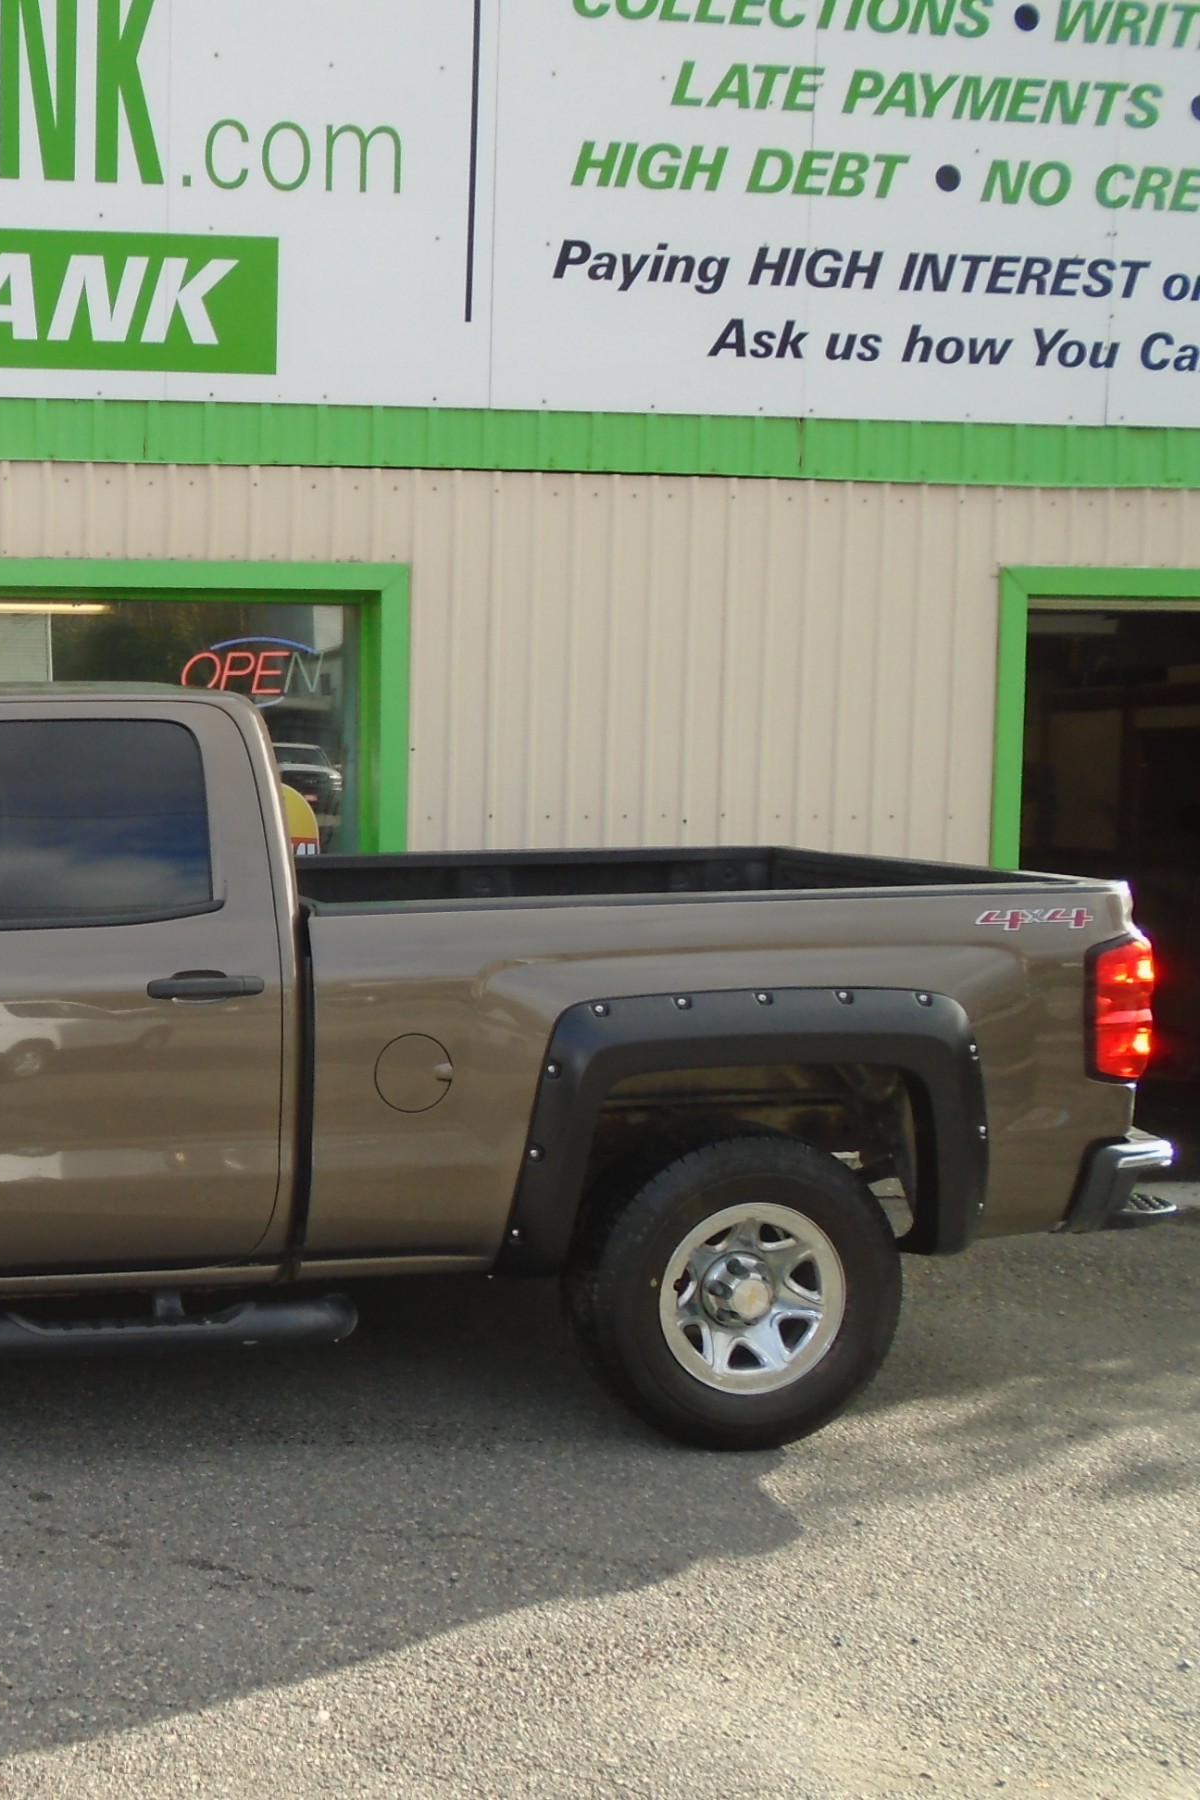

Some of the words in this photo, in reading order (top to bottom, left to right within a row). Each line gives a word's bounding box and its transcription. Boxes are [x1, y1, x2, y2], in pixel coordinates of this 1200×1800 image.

[670, 61, 825, 112] LATE
[841, 69, 1164, 129] PAYMENTS
[570, 141, 729, 192] HIGH
[746, 148, 909, 200] DEBT
[980, 159, 1072, 207] NO
[552, 239, 729, 295] Paying
[748, 246, 882, 290] HIGH
[898, 252, 1151, 300] INTEREST
[708, 318, 810, 360] Ask
[825, 332, 882, 363] us
[902, 324, 1013, 366] how
[1032, 328, 1120, 369] You
[181, 650, 326, 694] OPEN
